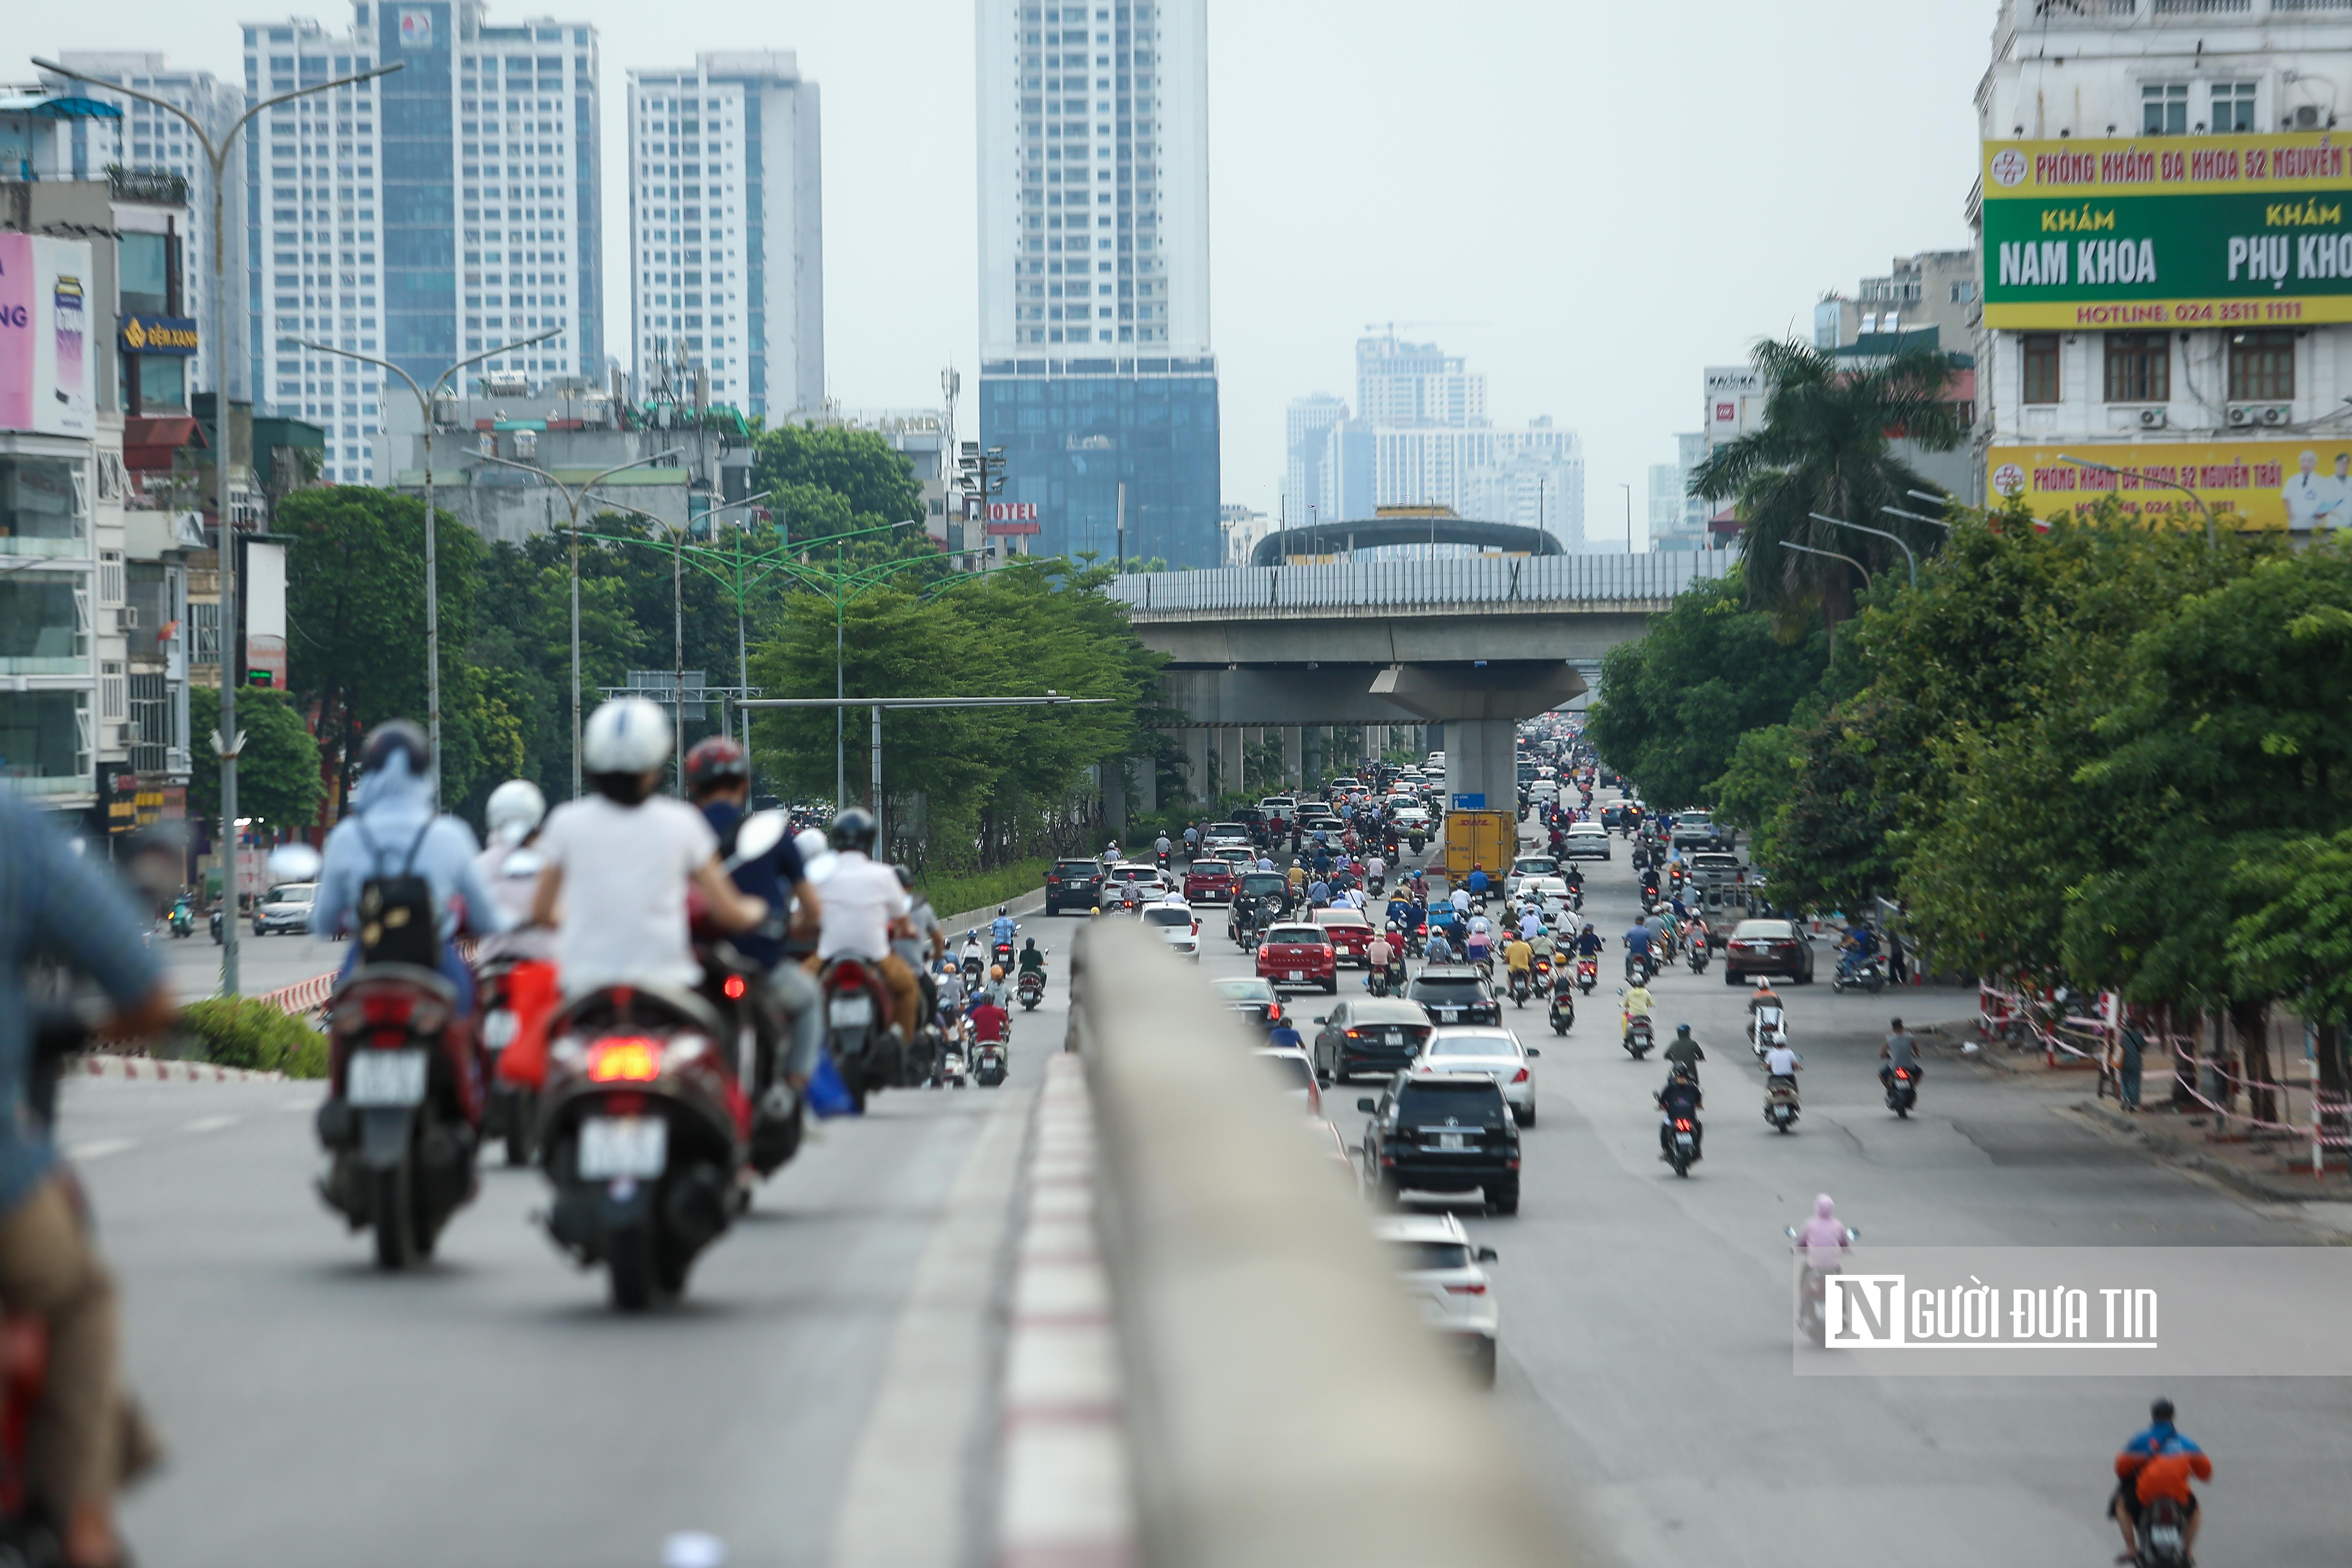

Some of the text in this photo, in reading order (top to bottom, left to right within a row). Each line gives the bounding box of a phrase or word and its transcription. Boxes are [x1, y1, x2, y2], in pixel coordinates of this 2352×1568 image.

[2100, 143, 2155, 184] KHÁM
[2160, 150, 2186, 182] ĐA
[2191, 149, 2238, 181] KHOA
[2245, 148, 2267, 180] 52
[2041, 202, 2115, 232] KHÁM
[2265, 196, 2342, 227] KHÁM
[1999, 237, 2157, 286] NAM KHOA
[2227, 233, 2289, 290] PHỤ
[2174, 303, 2214, 321] 024
[2218, 301, 2260, 320] 3511
[2265, 300, 2302, 319] 1111
[880, 417, 941, 431] LAND
[2181, 465, 2196, 489] 52
